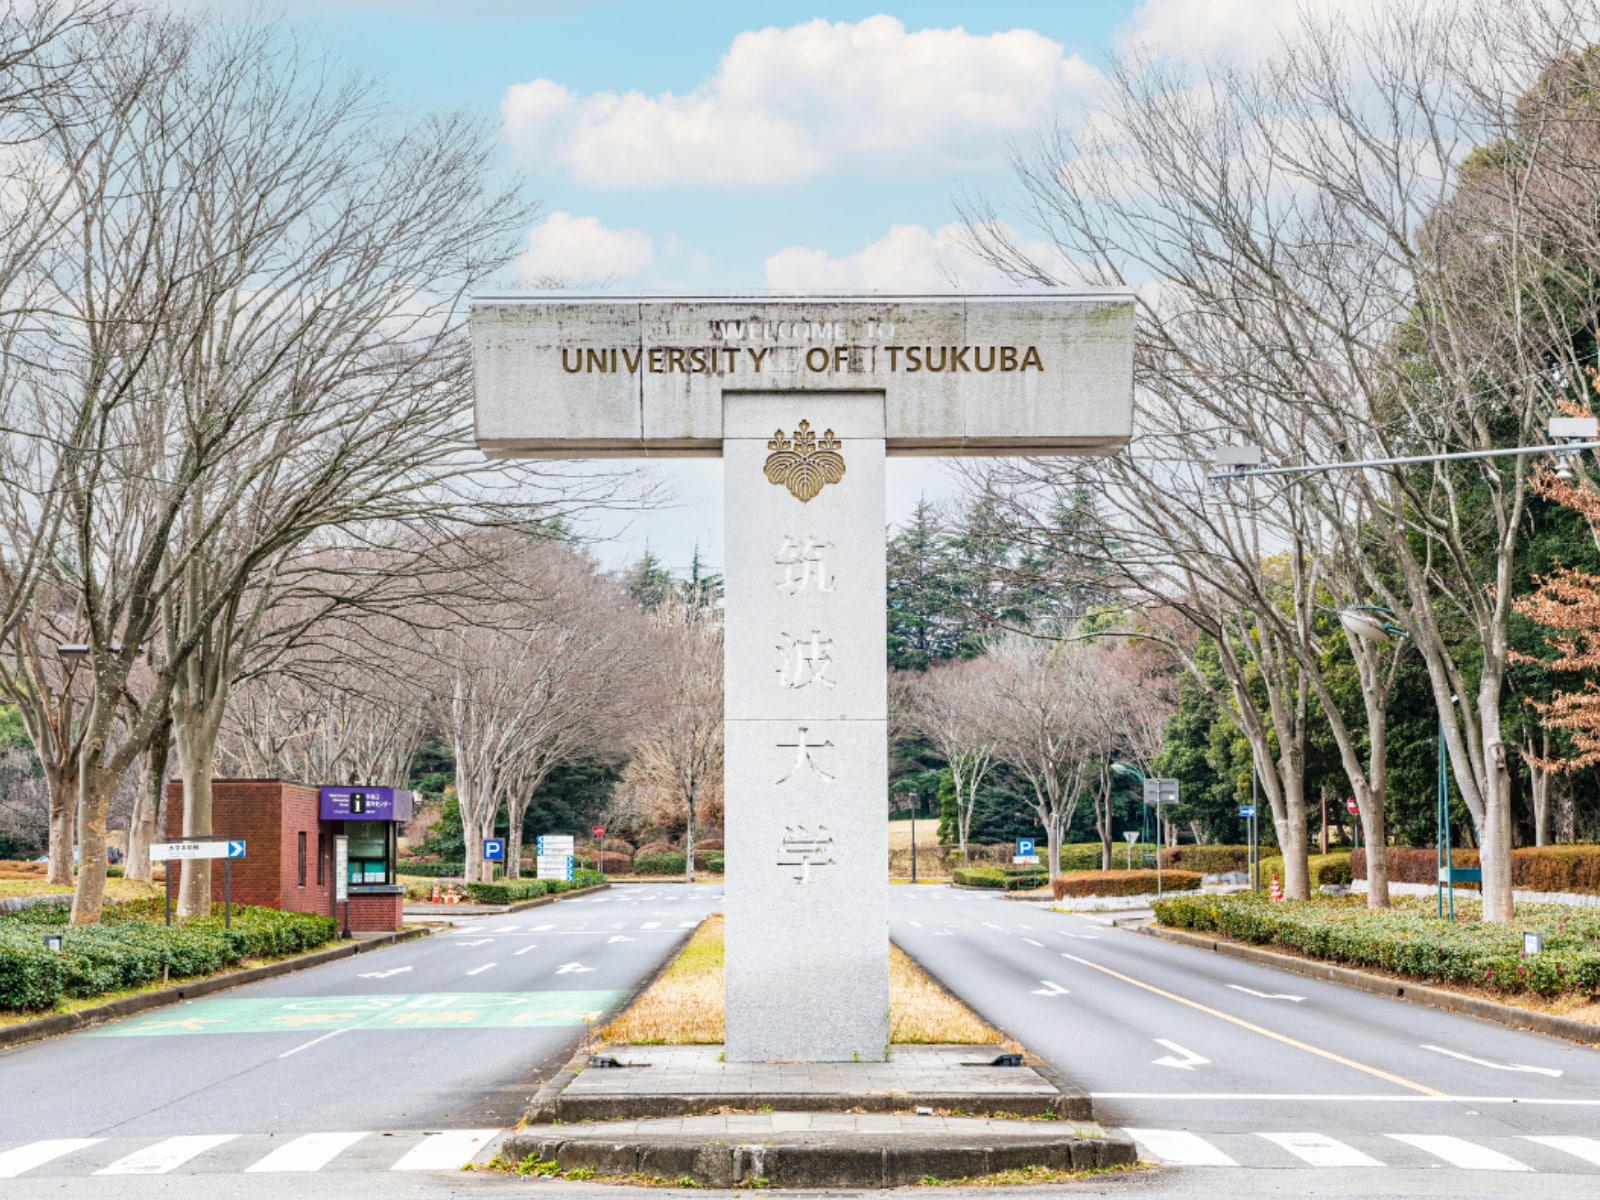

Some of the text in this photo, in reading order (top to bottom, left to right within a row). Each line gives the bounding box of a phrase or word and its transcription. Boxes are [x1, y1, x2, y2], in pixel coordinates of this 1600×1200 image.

[716, 321, 895, 339] WELCOME TO
[562, 345, 1045, 374] UNIVERSITY OF TSUKUBA
[774, 534, 837, 886] 筑波大学
[485, 842, 500, 858] P
[1020, 841, 1032, 855] P
